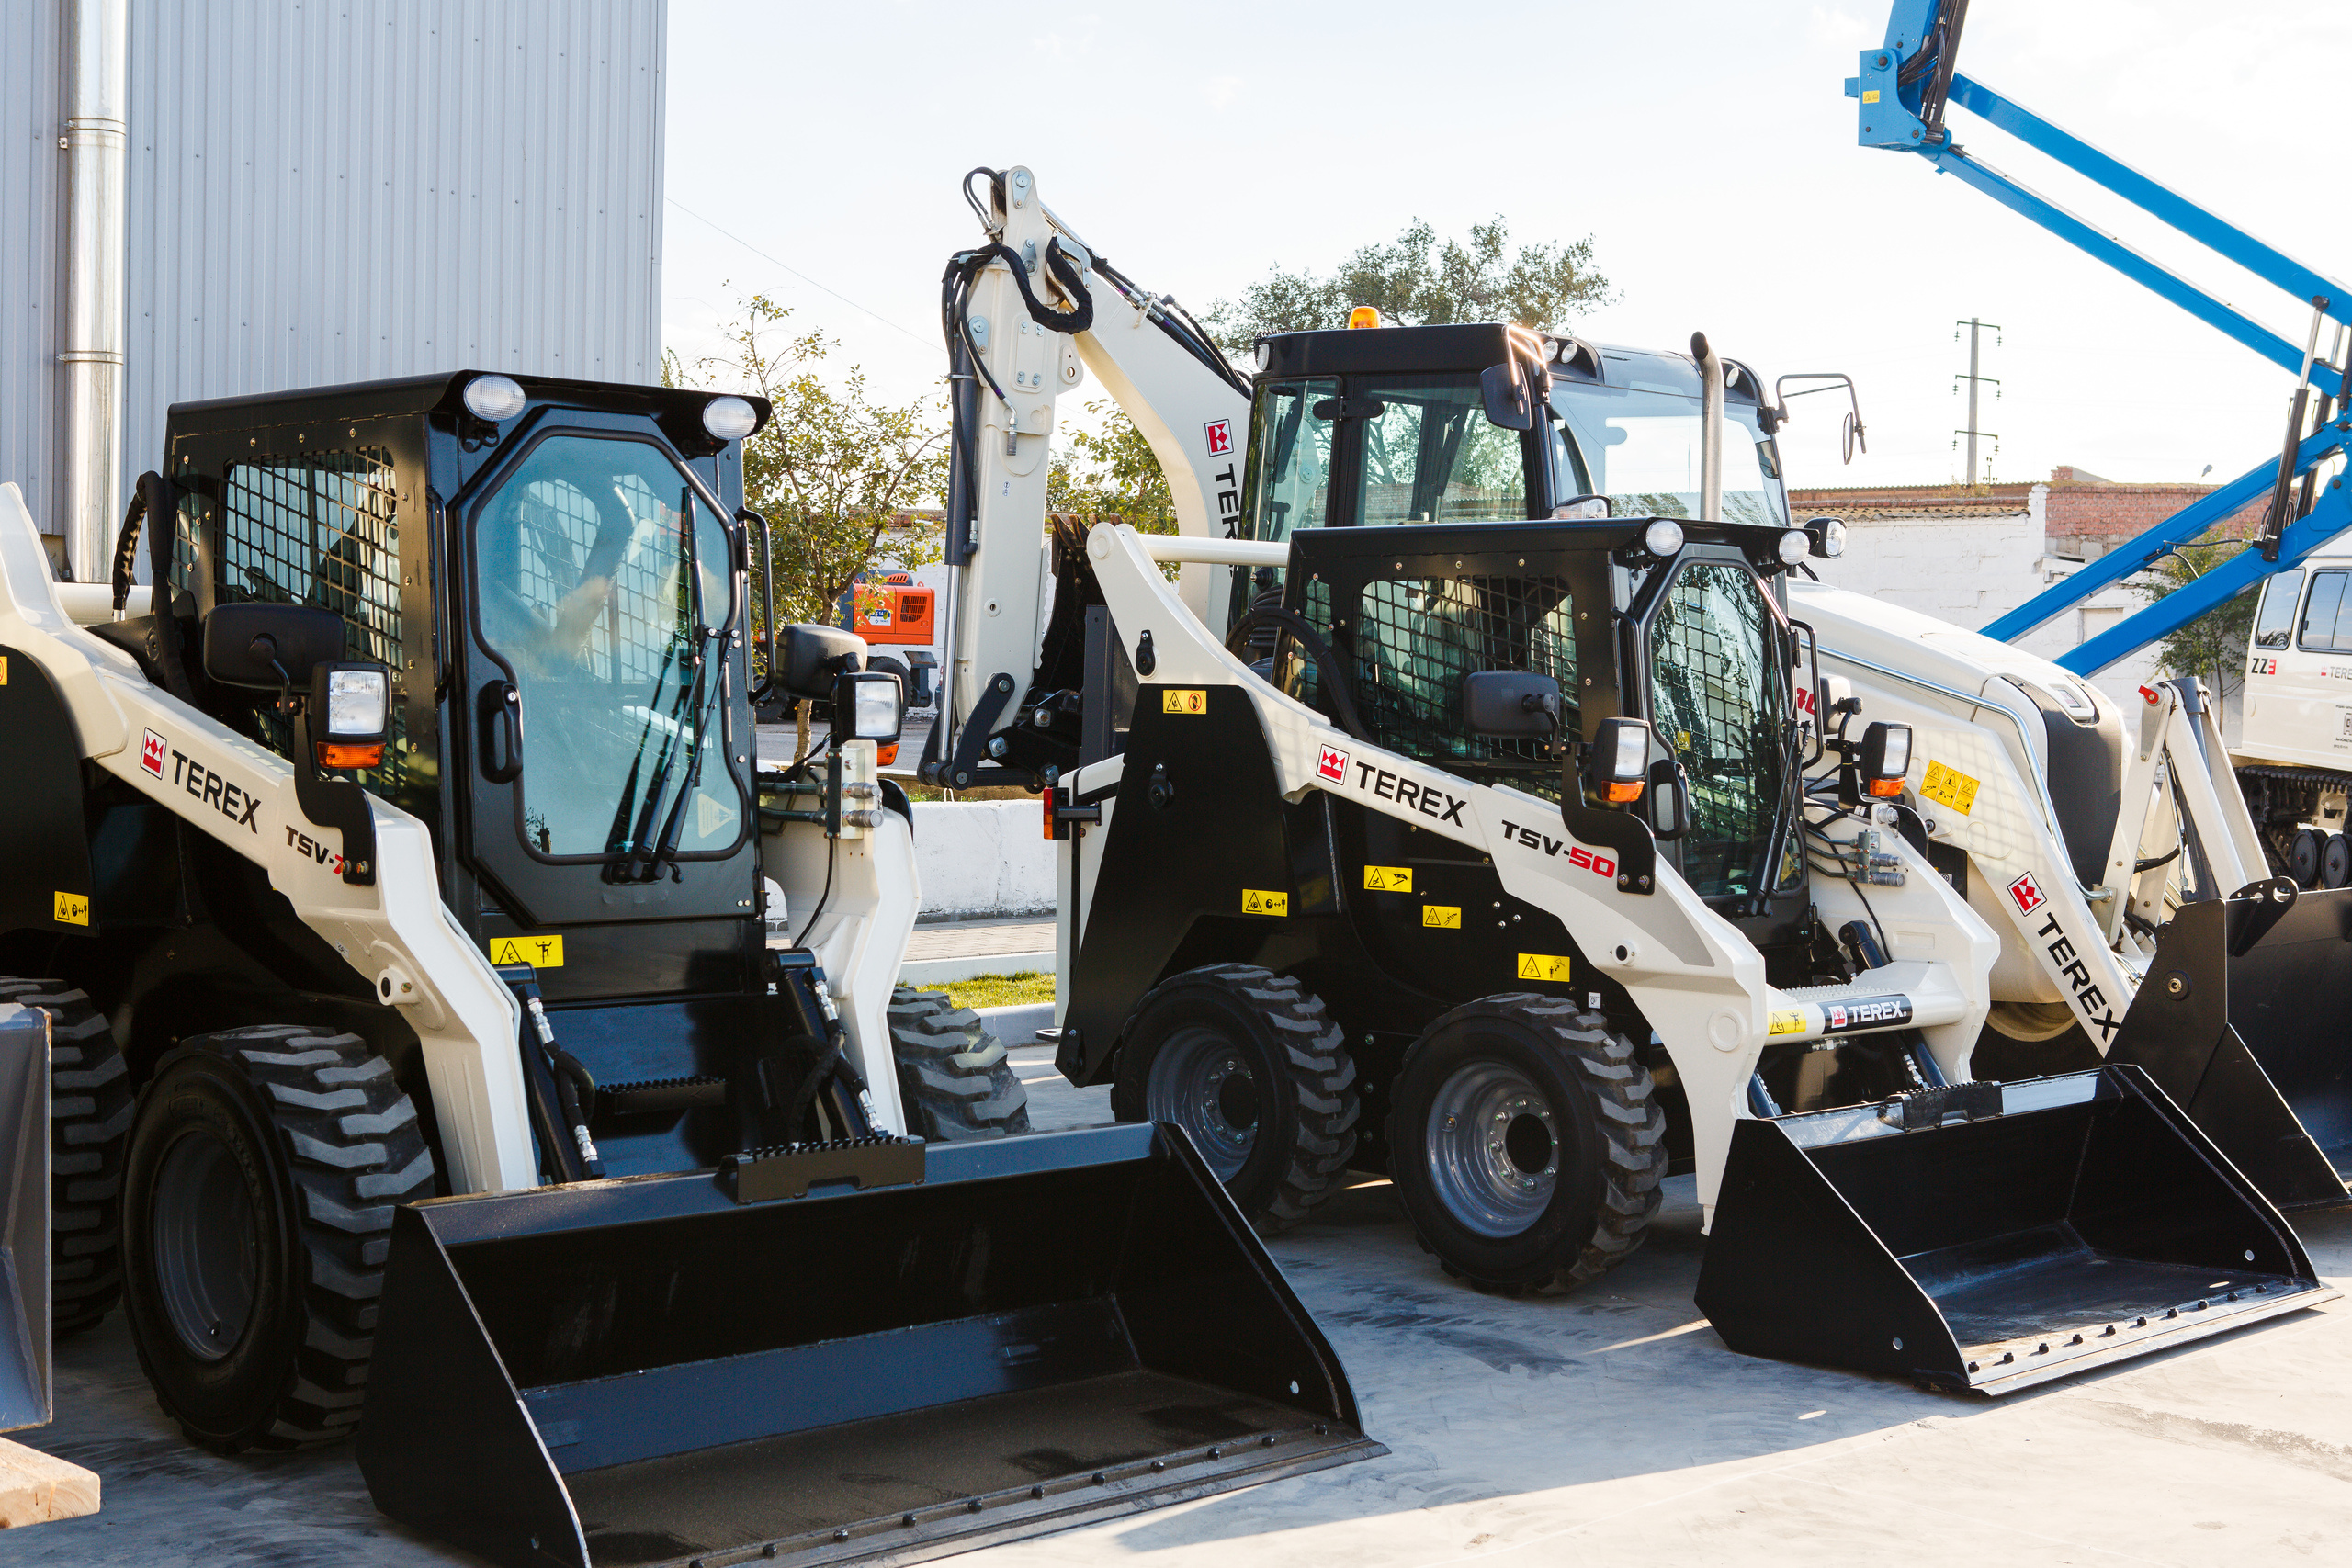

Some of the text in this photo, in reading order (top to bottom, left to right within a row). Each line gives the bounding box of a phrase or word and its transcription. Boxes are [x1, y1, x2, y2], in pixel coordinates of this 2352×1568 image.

[1215, 463, 1240, 578] TER
[2329, 666, 2352, 681] TERE
[171, 748, 262, 835] TEREX
[1356, 761, 1467, 829] TEREX
[285, 824, 345, 876] TSV-7
[1501, 819, 1616, 879] TSV-50
[2037, 911, 2121, 1043] TEREX
